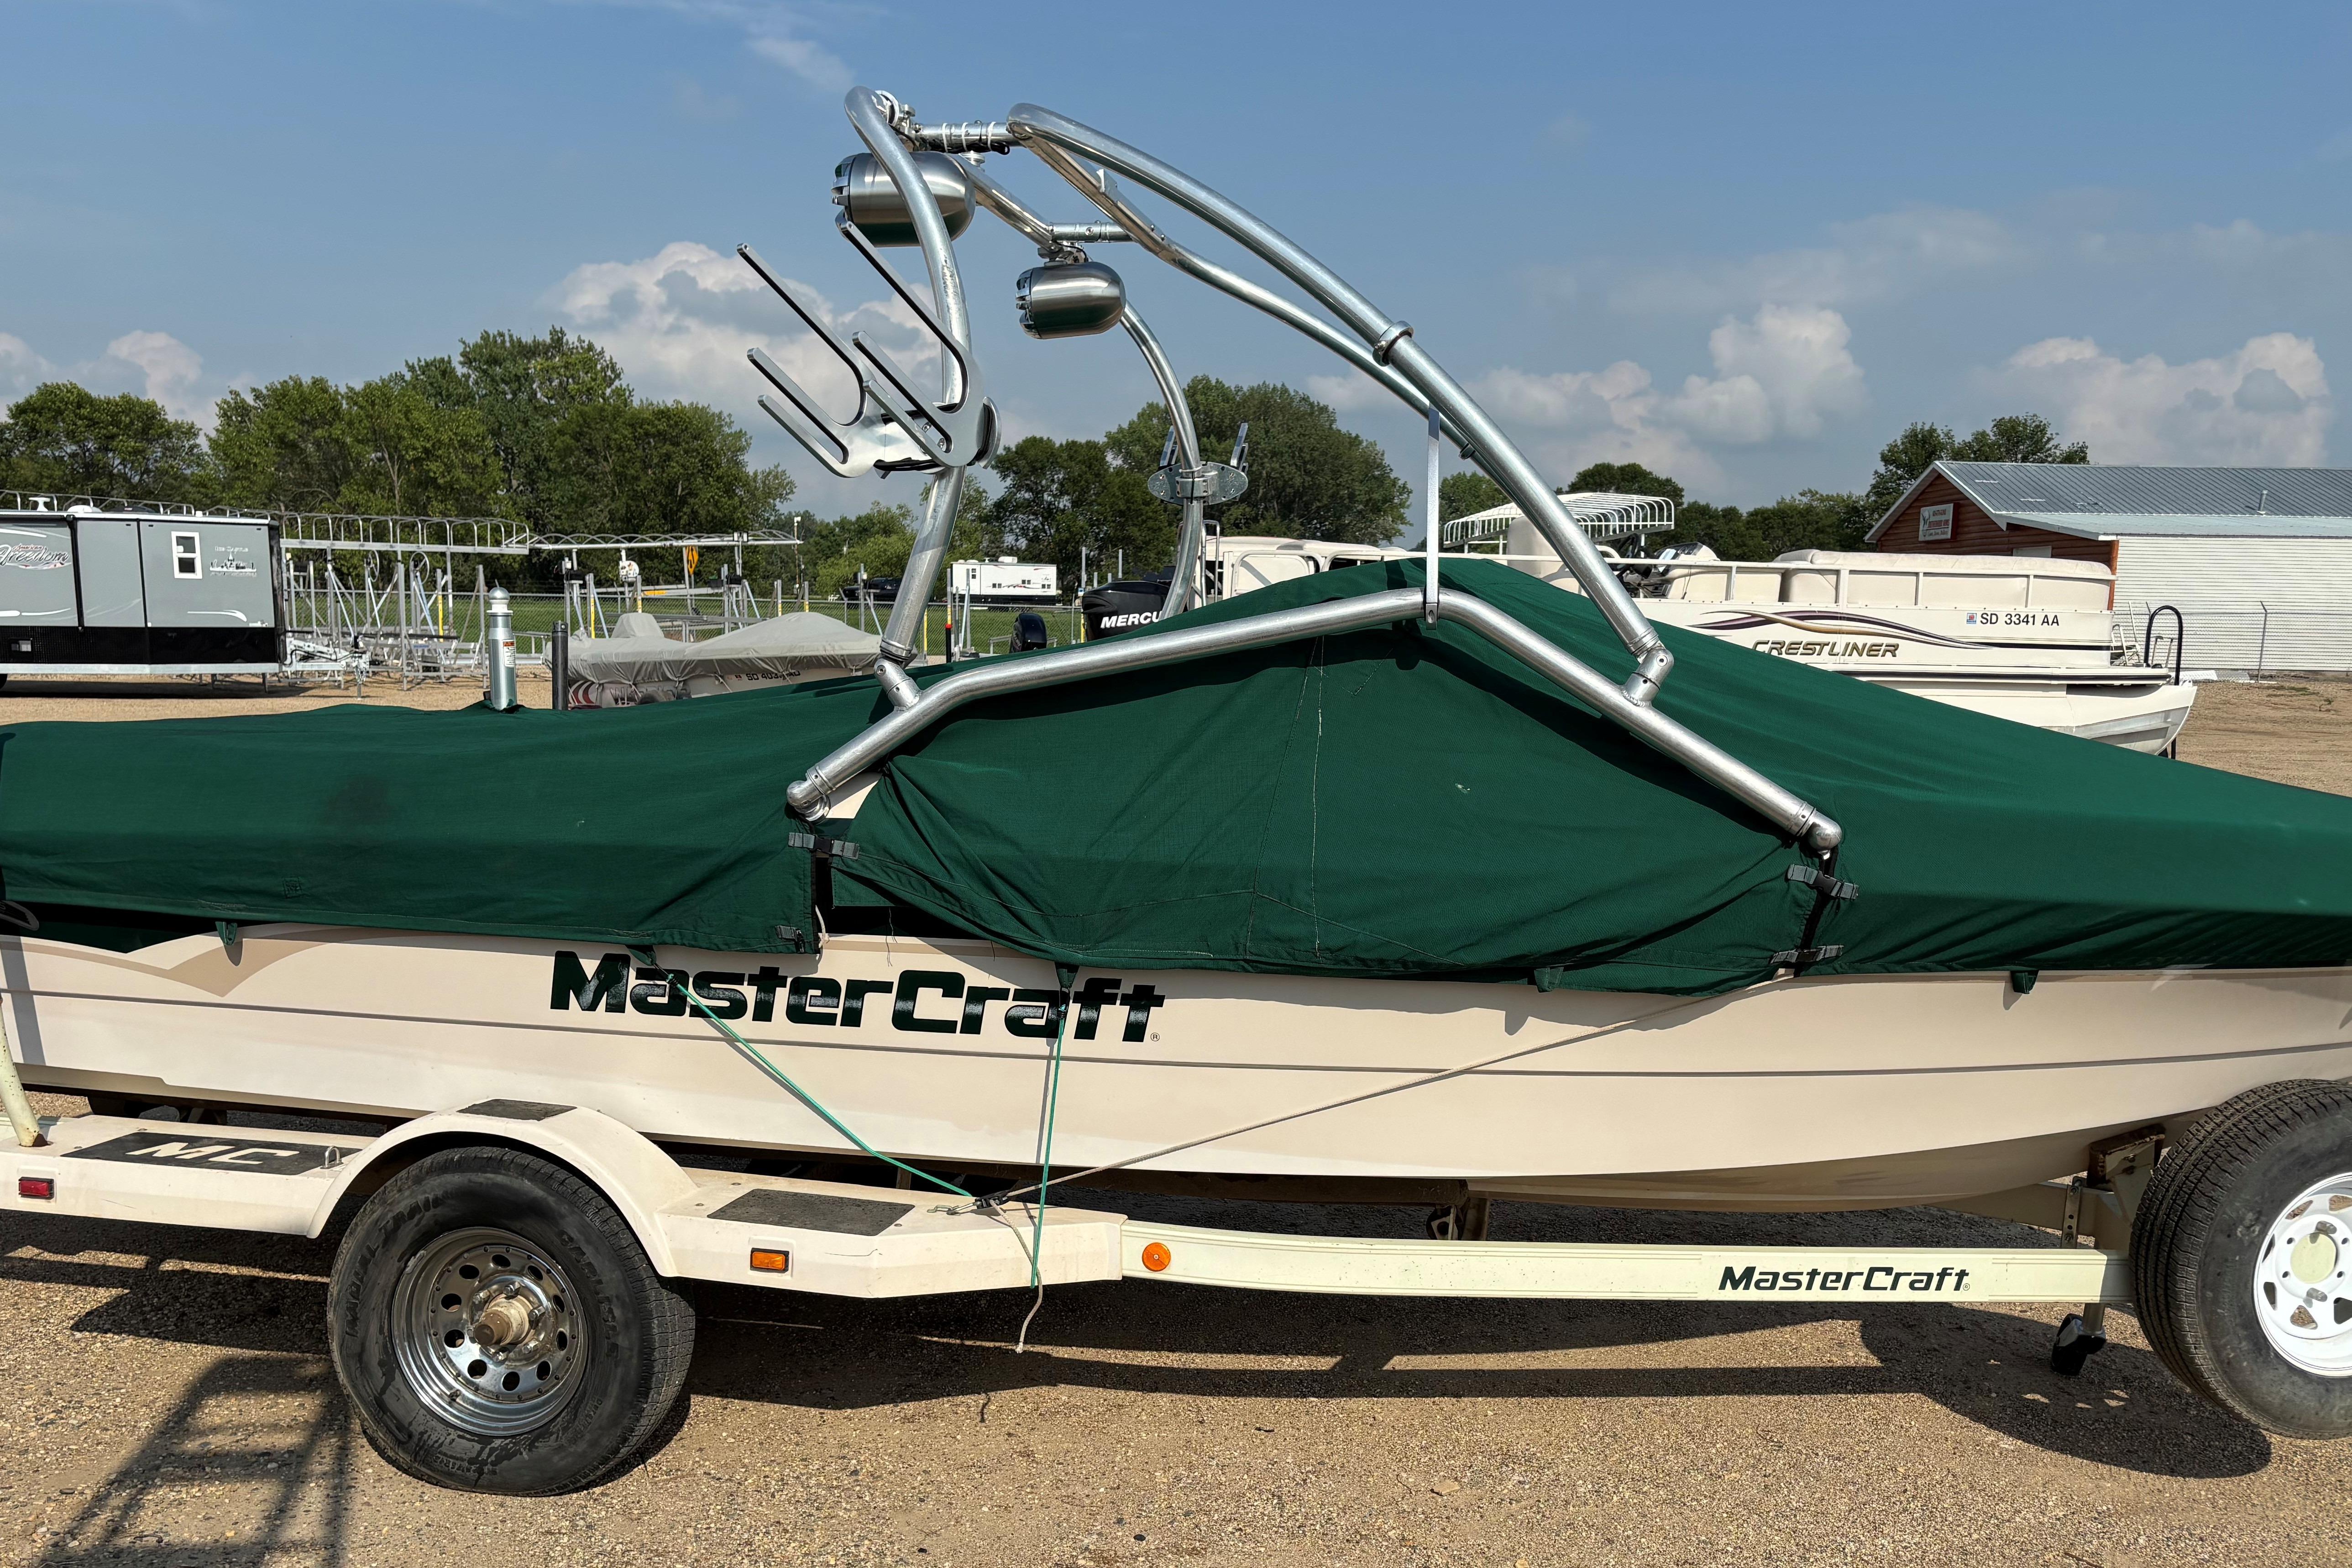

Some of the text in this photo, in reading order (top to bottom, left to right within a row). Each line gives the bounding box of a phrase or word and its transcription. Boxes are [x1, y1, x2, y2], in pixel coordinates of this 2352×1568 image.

[1100, 611, 1163, 629] MERCU
[1980, 613, 1999, 624] SD
[2004, 614, 2036, 625] 3341
[2041, 614, 2059, 626] AA
[1752, 640, 1899, 657] CRESTLINER
[550, 950, 1165, 1043] MasterCraft
[126, 1142, 300, 1164] MC
[1718, 1266, 1970, 1291] MasterCraft
